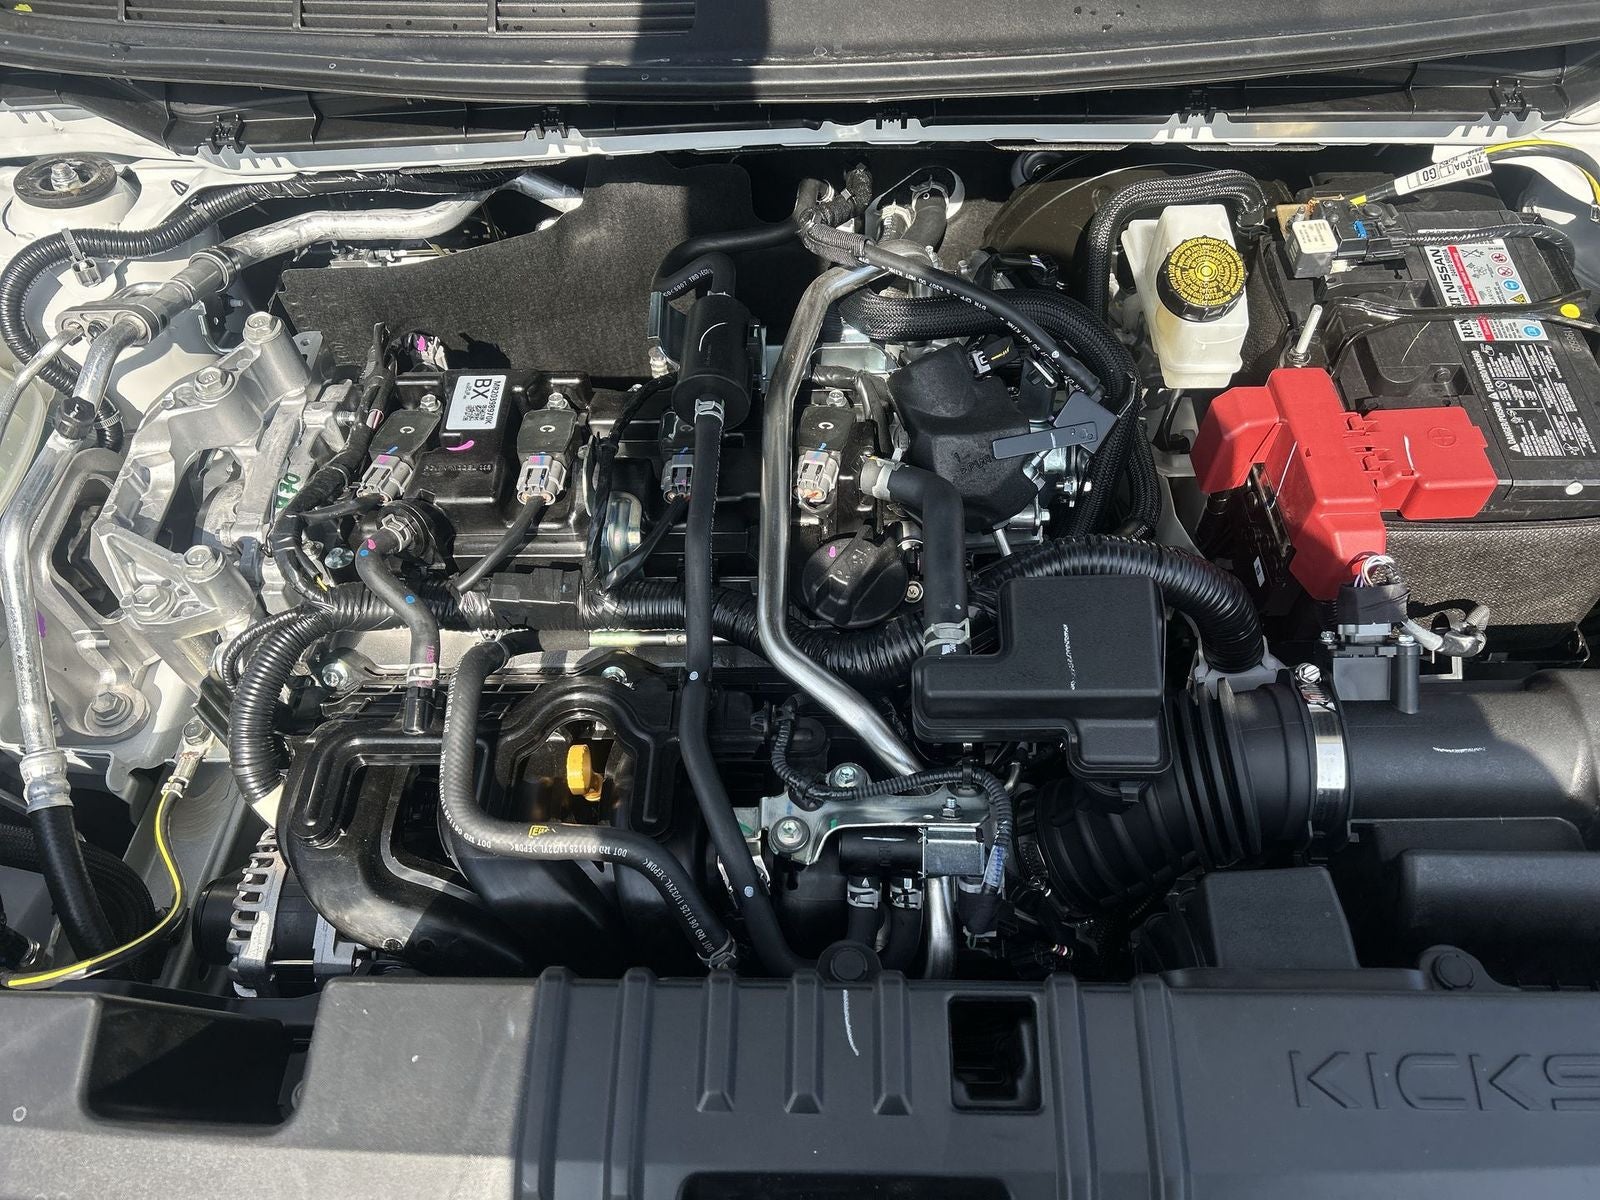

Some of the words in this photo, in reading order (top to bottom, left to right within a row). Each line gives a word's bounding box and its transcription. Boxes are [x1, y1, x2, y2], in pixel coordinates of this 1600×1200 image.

[1429, 249, 1456, 293] NISSAN
[470, 379, 492, 400] BX
[679, 903, 700, 929] 061125
[1288, 1050, 1600, 1111] KICKS
